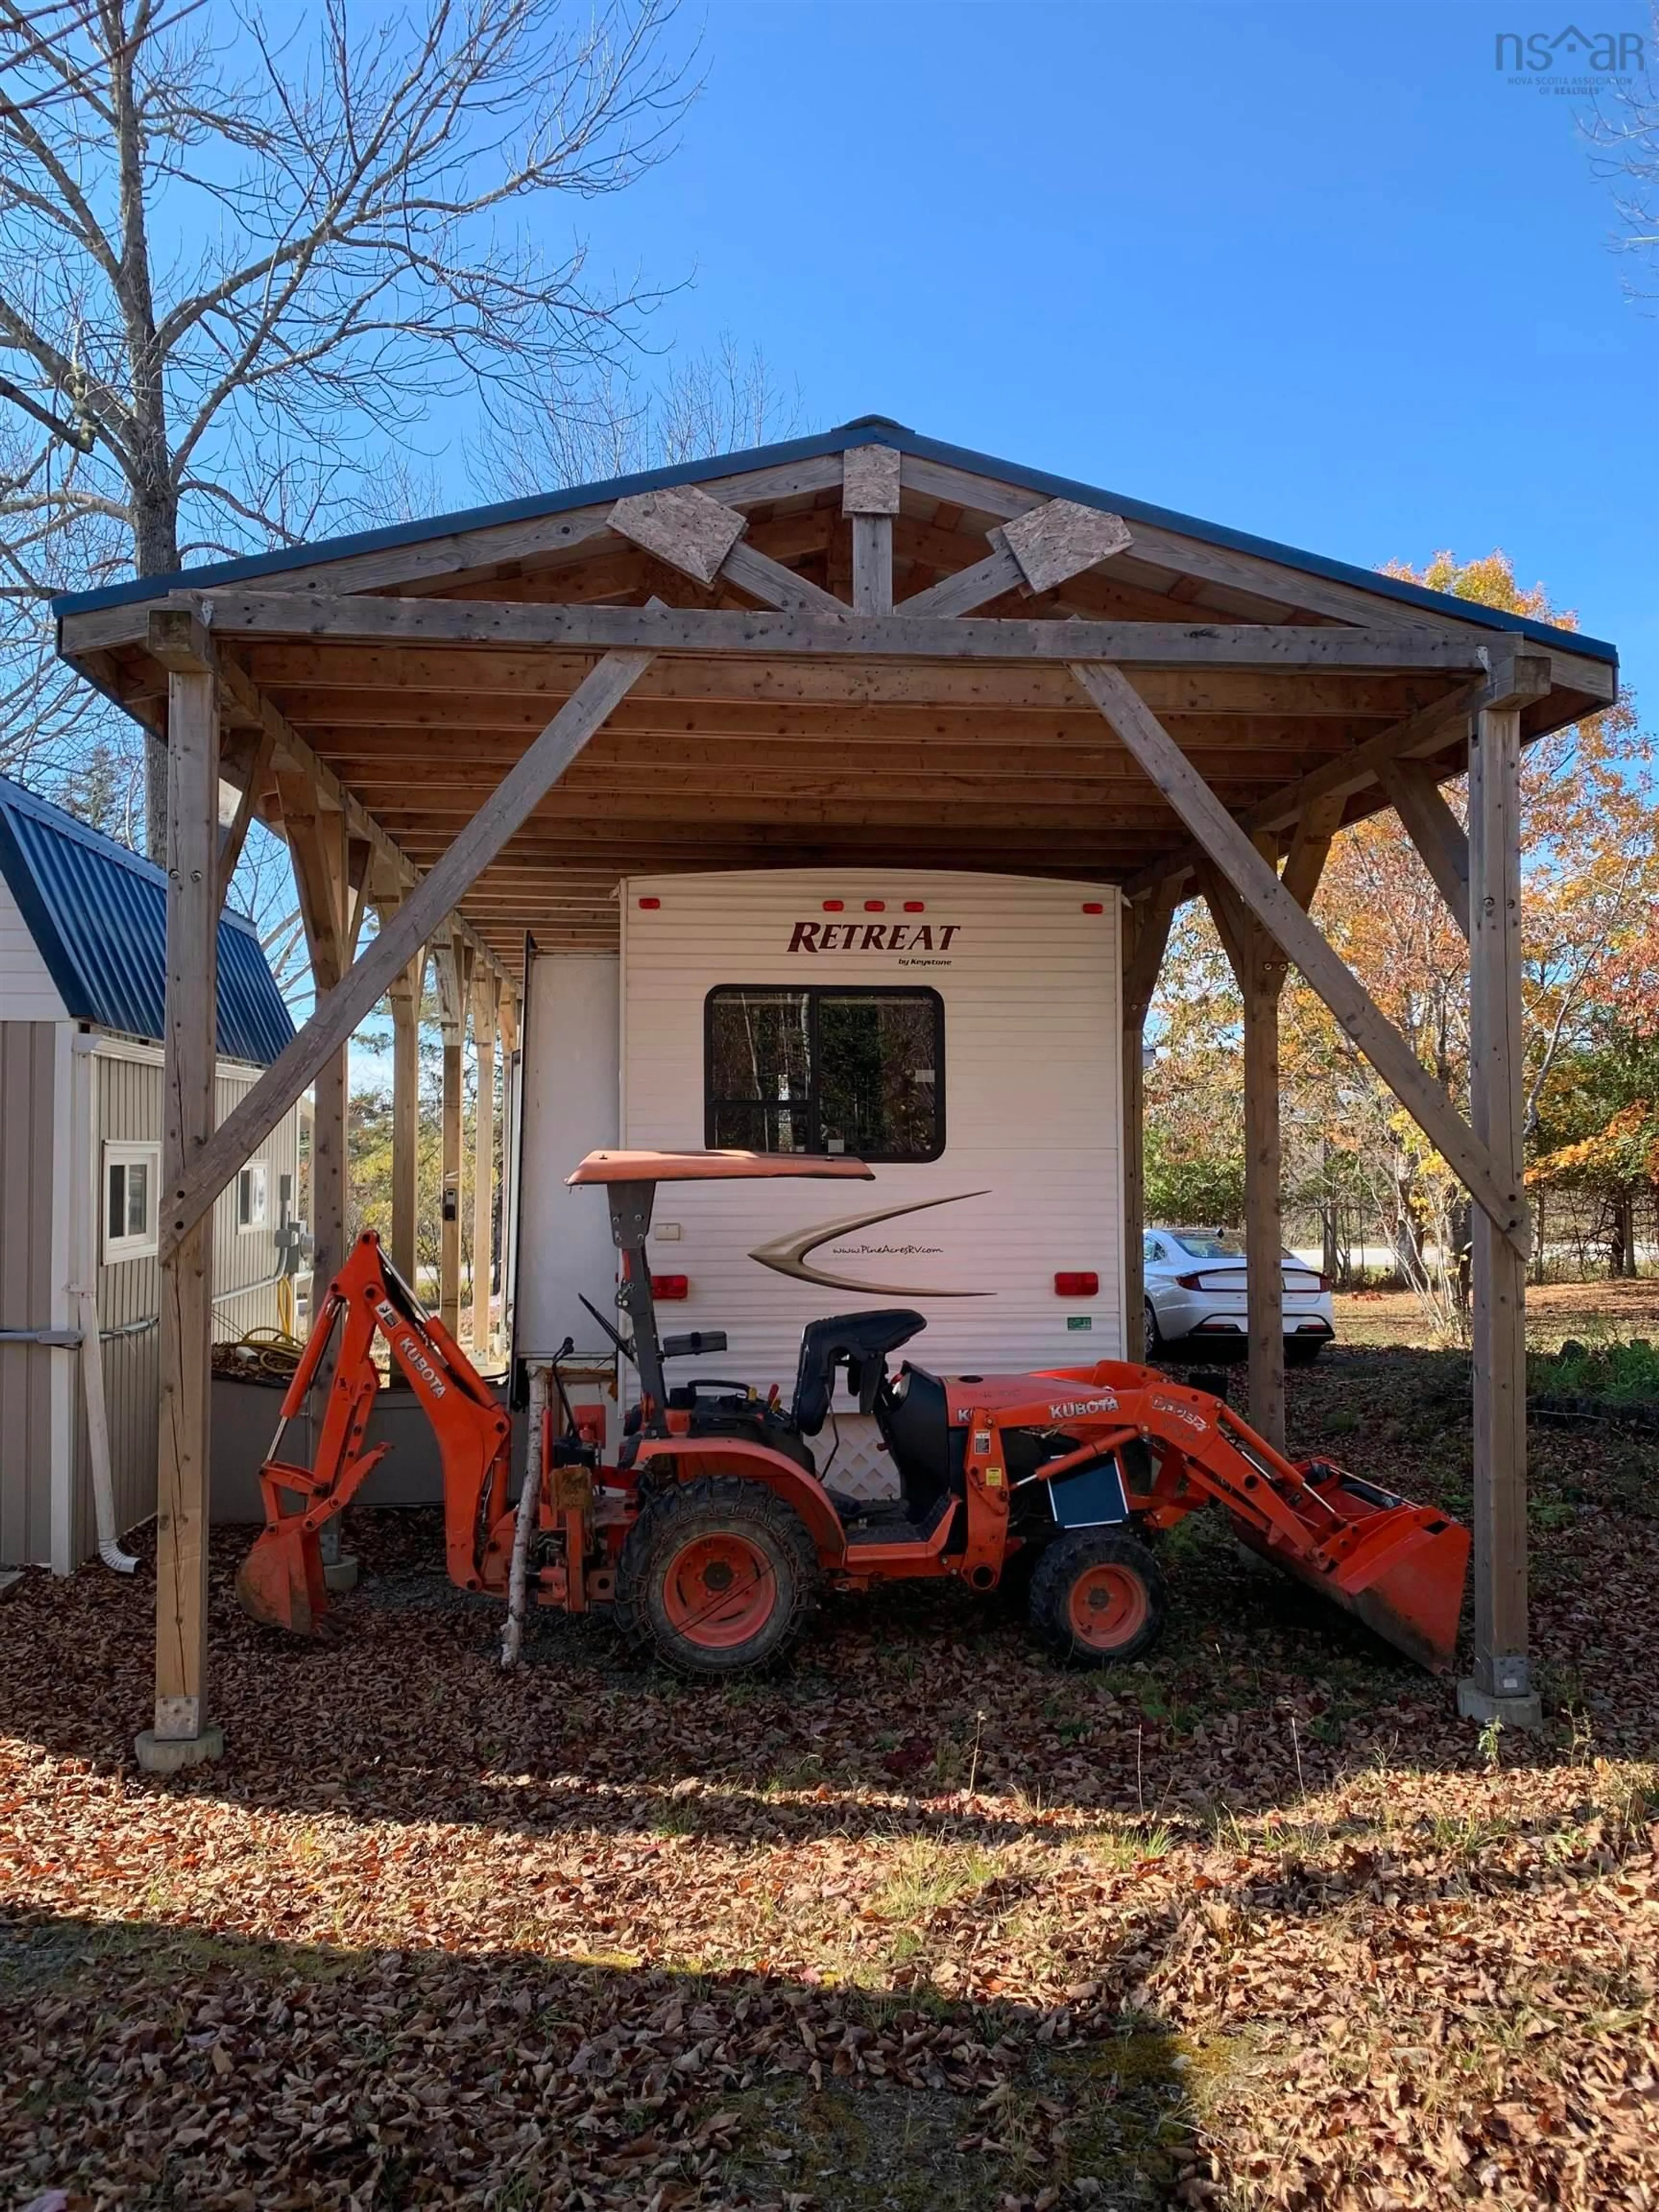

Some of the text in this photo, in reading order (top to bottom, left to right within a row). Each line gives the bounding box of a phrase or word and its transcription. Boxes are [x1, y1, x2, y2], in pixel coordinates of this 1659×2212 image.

[787, 922, 961, 953] RETREAT
[400, 1337, 446, 1399] KUBOTA
[1049, 1397, 1119, 1419] KUBOTA
